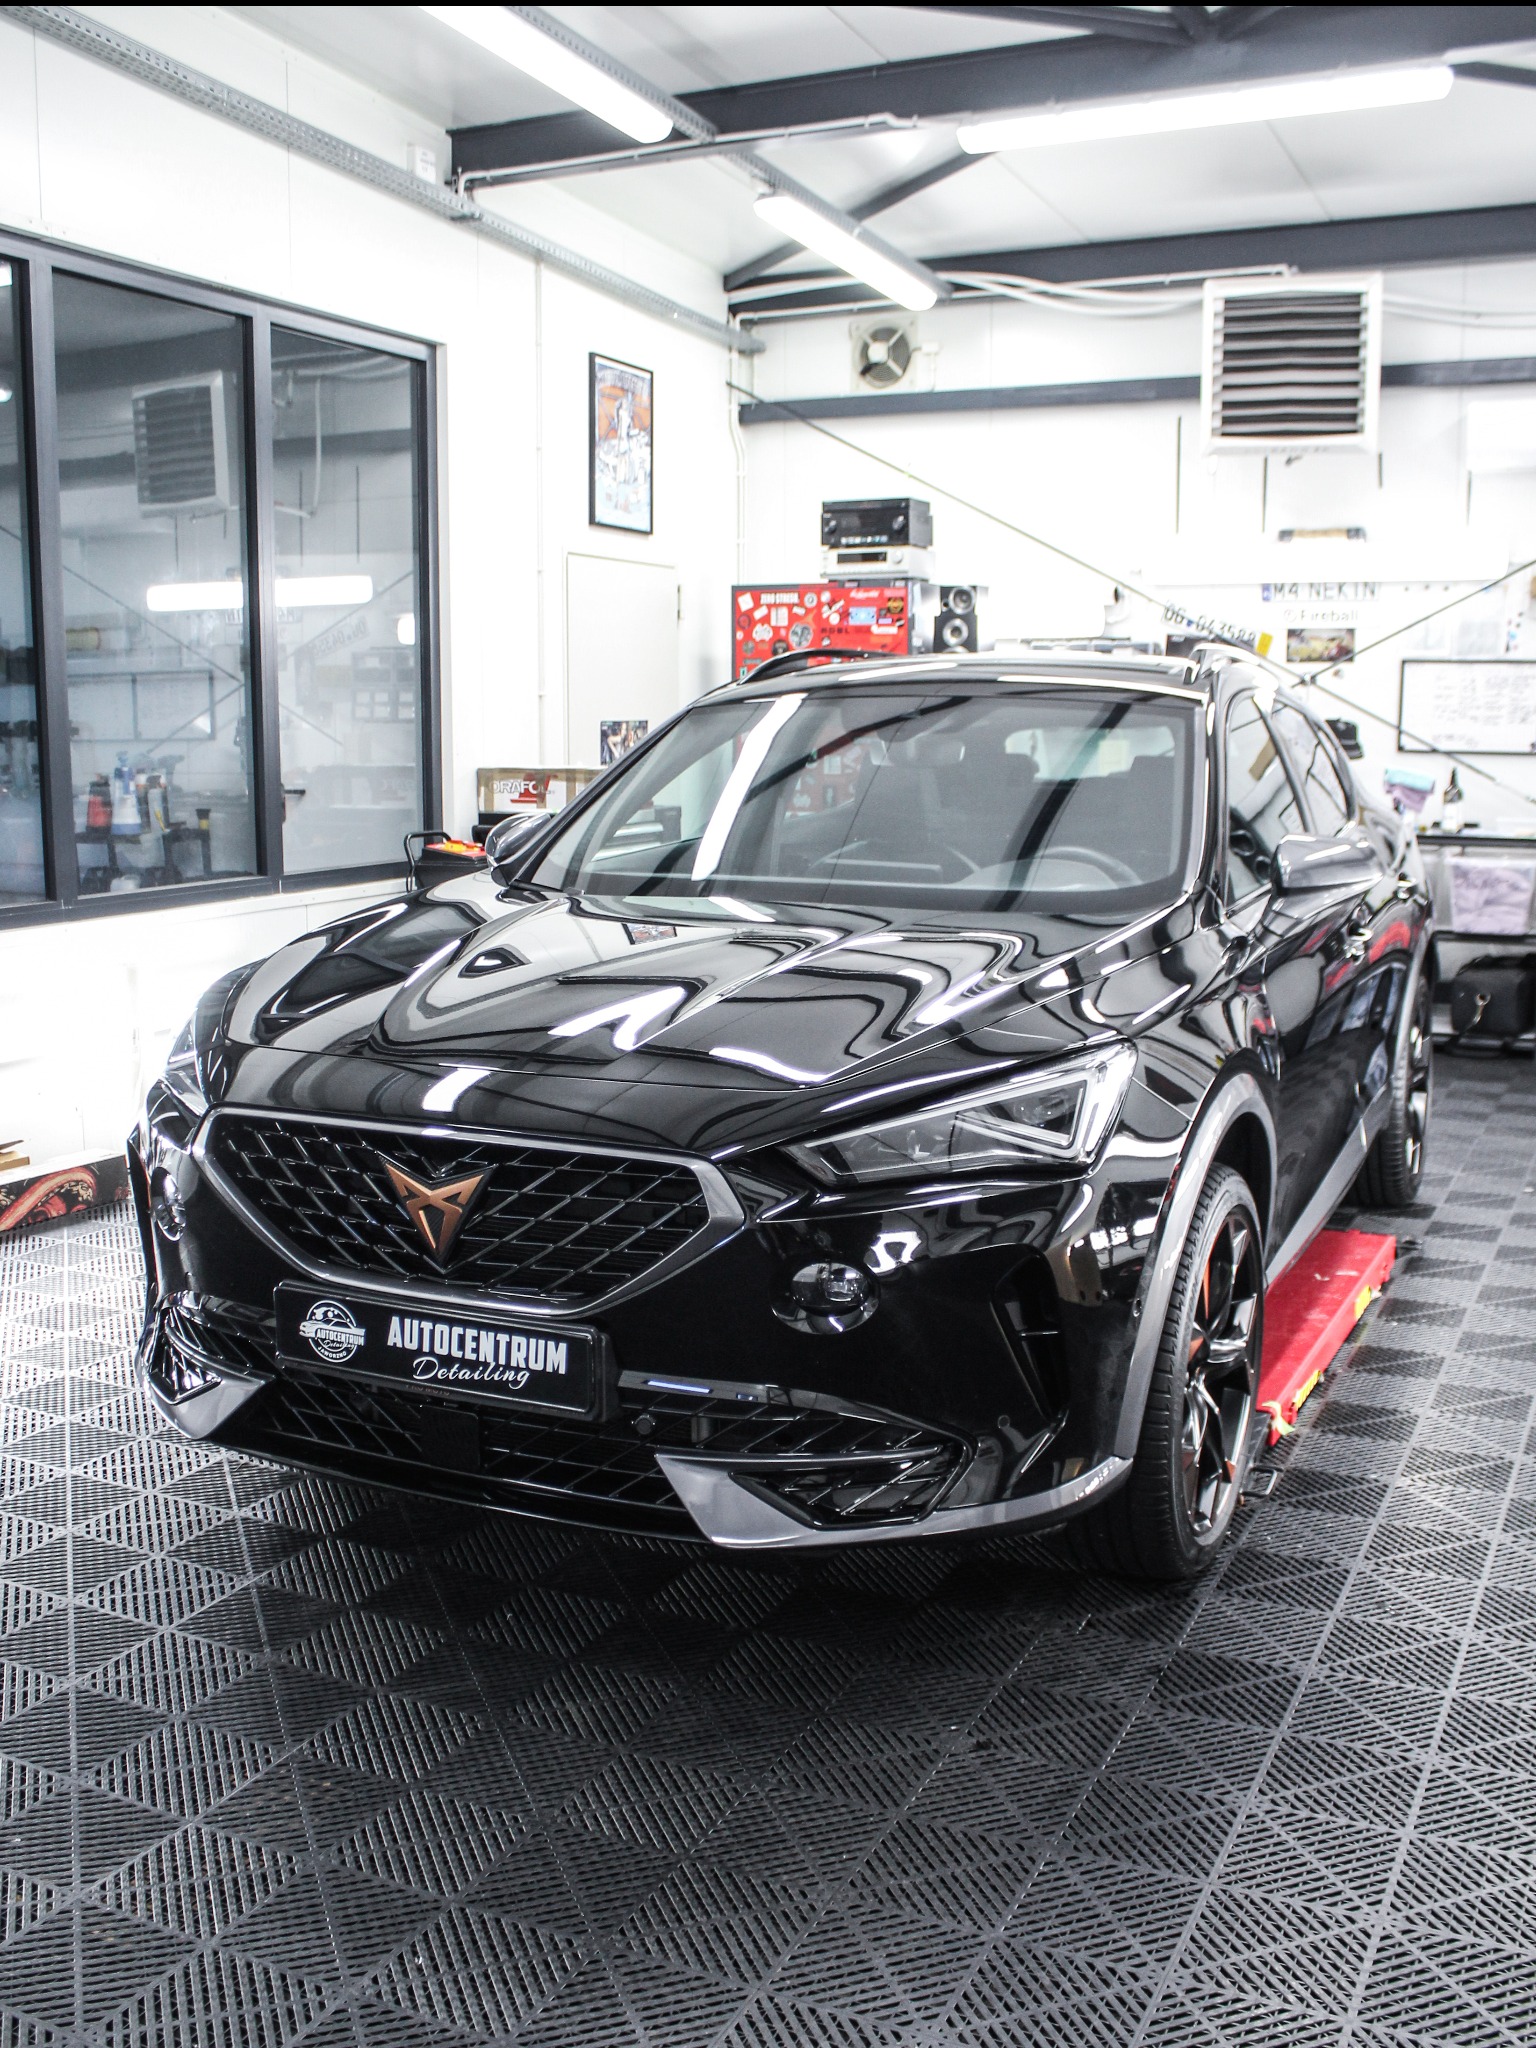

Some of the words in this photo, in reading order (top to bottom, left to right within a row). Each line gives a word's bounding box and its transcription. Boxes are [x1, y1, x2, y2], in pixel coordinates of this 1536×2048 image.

[316, 1328, 365, 1346] AUTOCENTRUM
[387, 1316, 567, 1375] AUTOCENTRUM
[412, 1356, 530, 1390] Detailing
